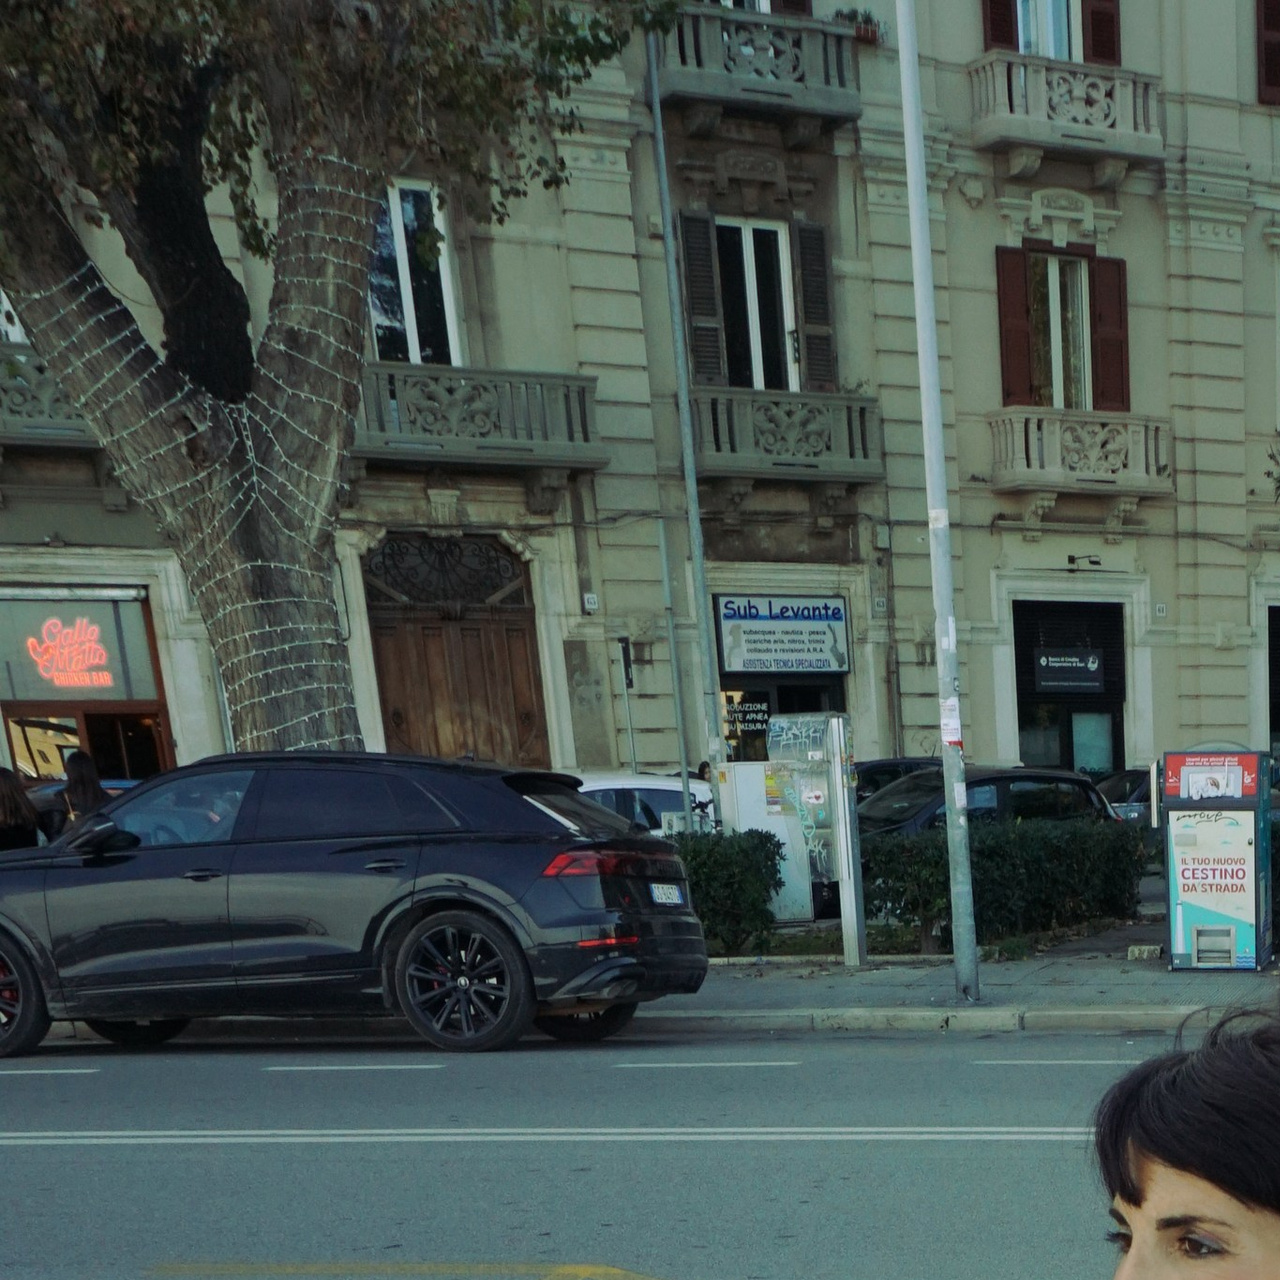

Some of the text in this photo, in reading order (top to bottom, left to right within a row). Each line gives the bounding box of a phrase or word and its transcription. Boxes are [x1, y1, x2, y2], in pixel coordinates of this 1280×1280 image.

[723, 600, 842, 620] Sub Levante
[42, 618, 100, 646] Gallo
[743, 629, 776, 637] subacquea
[743, 659, 831, 669] ASSISTENZA TECNICA SPECIALIZZATA
[92, 671, 113, 687] BAR
[723, 702, 768, 711] RODUZIONE
[746, 712, 769, 720] APNEA
[1191, 858, 1210, 866] TUO
[1213, 858, 1246, 866] NUOVO
[1181, 868, 1246, 880] CESTINO
[1183, 883, 1246, 893] DA STRADA
